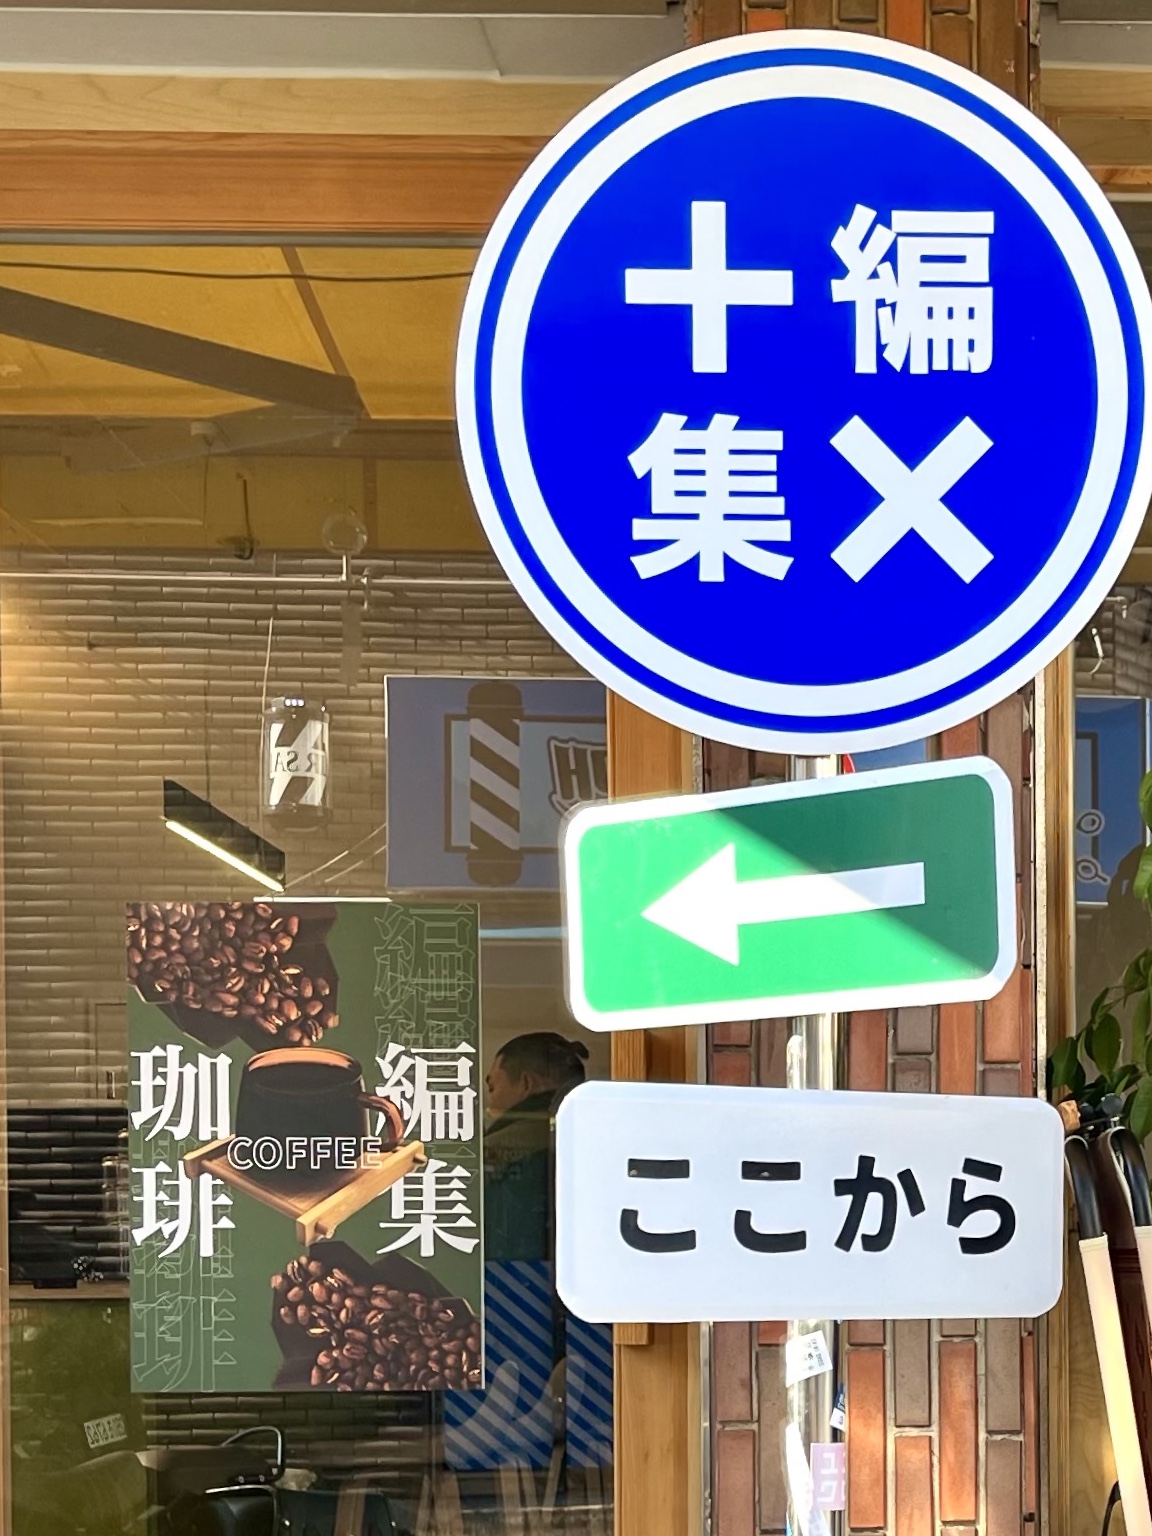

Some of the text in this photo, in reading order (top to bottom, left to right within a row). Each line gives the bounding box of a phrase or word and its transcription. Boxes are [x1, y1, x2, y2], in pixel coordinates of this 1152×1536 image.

[227, 1136, 383, 1170] COFFEE
[619, 1154, 1017, 1255] ここから
